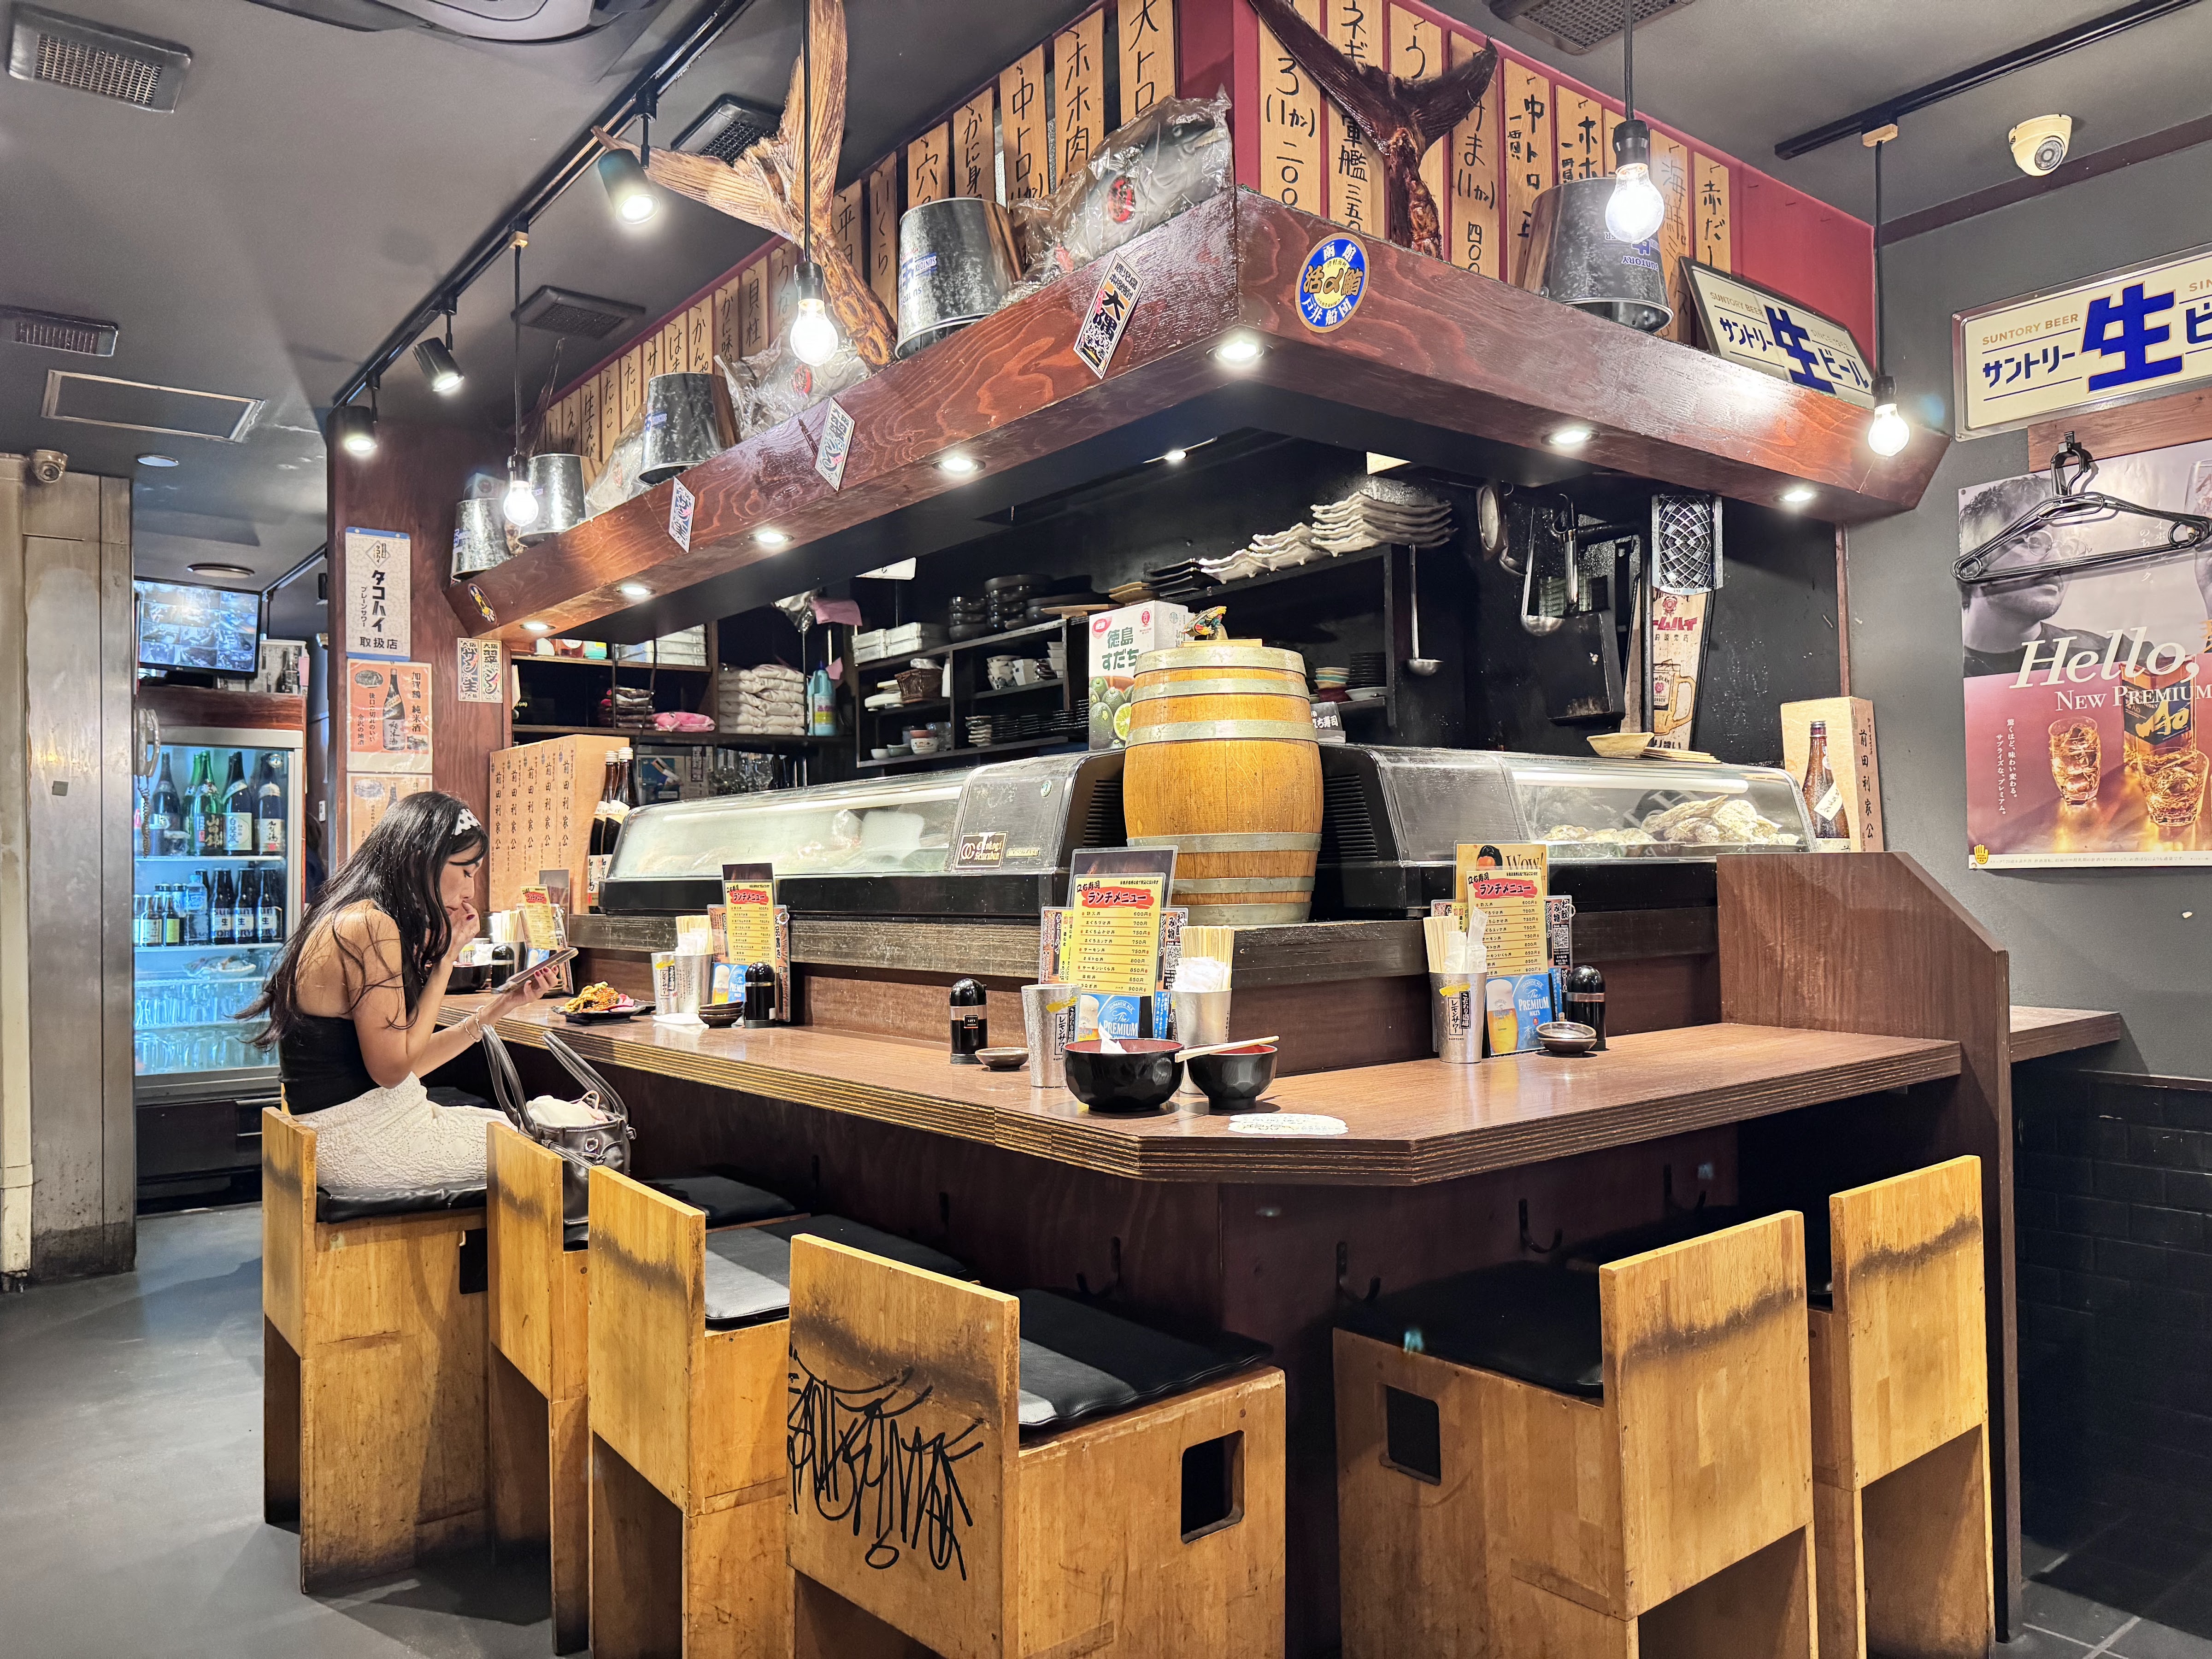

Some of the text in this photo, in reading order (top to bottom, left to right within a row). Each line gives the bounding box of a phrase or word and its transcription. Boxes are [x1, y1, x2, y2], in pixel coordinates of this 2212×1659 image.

[1013, 77, 1034, 182] 中トロ
[1524, 94, 1545, 190] 中トロ
[876, 179, 889, 276] いくら
[1710, 292, 1764, 317] SUNTORY BEER
[1719, 317, 1774, 352] サントリー
[1982, 313, 2079, 346] SUNTORY BEER
[2080, 281, 2184, 394] 生
[1763, 304, 1837, 396] 生
[1983, 345, 2075, 388] サントリー
[1818, 347, 1869, 389] ビール
[371, 570, 387, 633] タコハイ
[359, 636, 398, 650] 取扱店
[1107, 627, 1134, 649] 徳島
[1101, 648, 1140, 671] すだち
[2008, 626, 2200, 689] Hello,
[412, 671, 421, 732] 加賀鶴 純米酒
[1996, 734, 2006, 815] サプライズな、プレミアム。
[2006, 718, 2018, 798] 驚くほど、味わい変わる。
[1859, 729, 1874, 839] 前田利家公
[1077, 880, 1100, 893] 立ち寿司
[1468, 872, 1489, 885] 立ち寿司
[1480, 883, 1531, 895] ランチメニュー
[733, 893, 765, 901] ランチメニュー
[1088, 892, 1147, 904] ランチメニュー
[1518, 996, 1549, 1011] PREMIUM
[1525, 989, 1541, 999] The
[1103, 1020, 1139, 1037] PREMIUM
[1112, 1010, 1130, 1023] The
[1451, 999, 1459, 1034] レモンサワー
